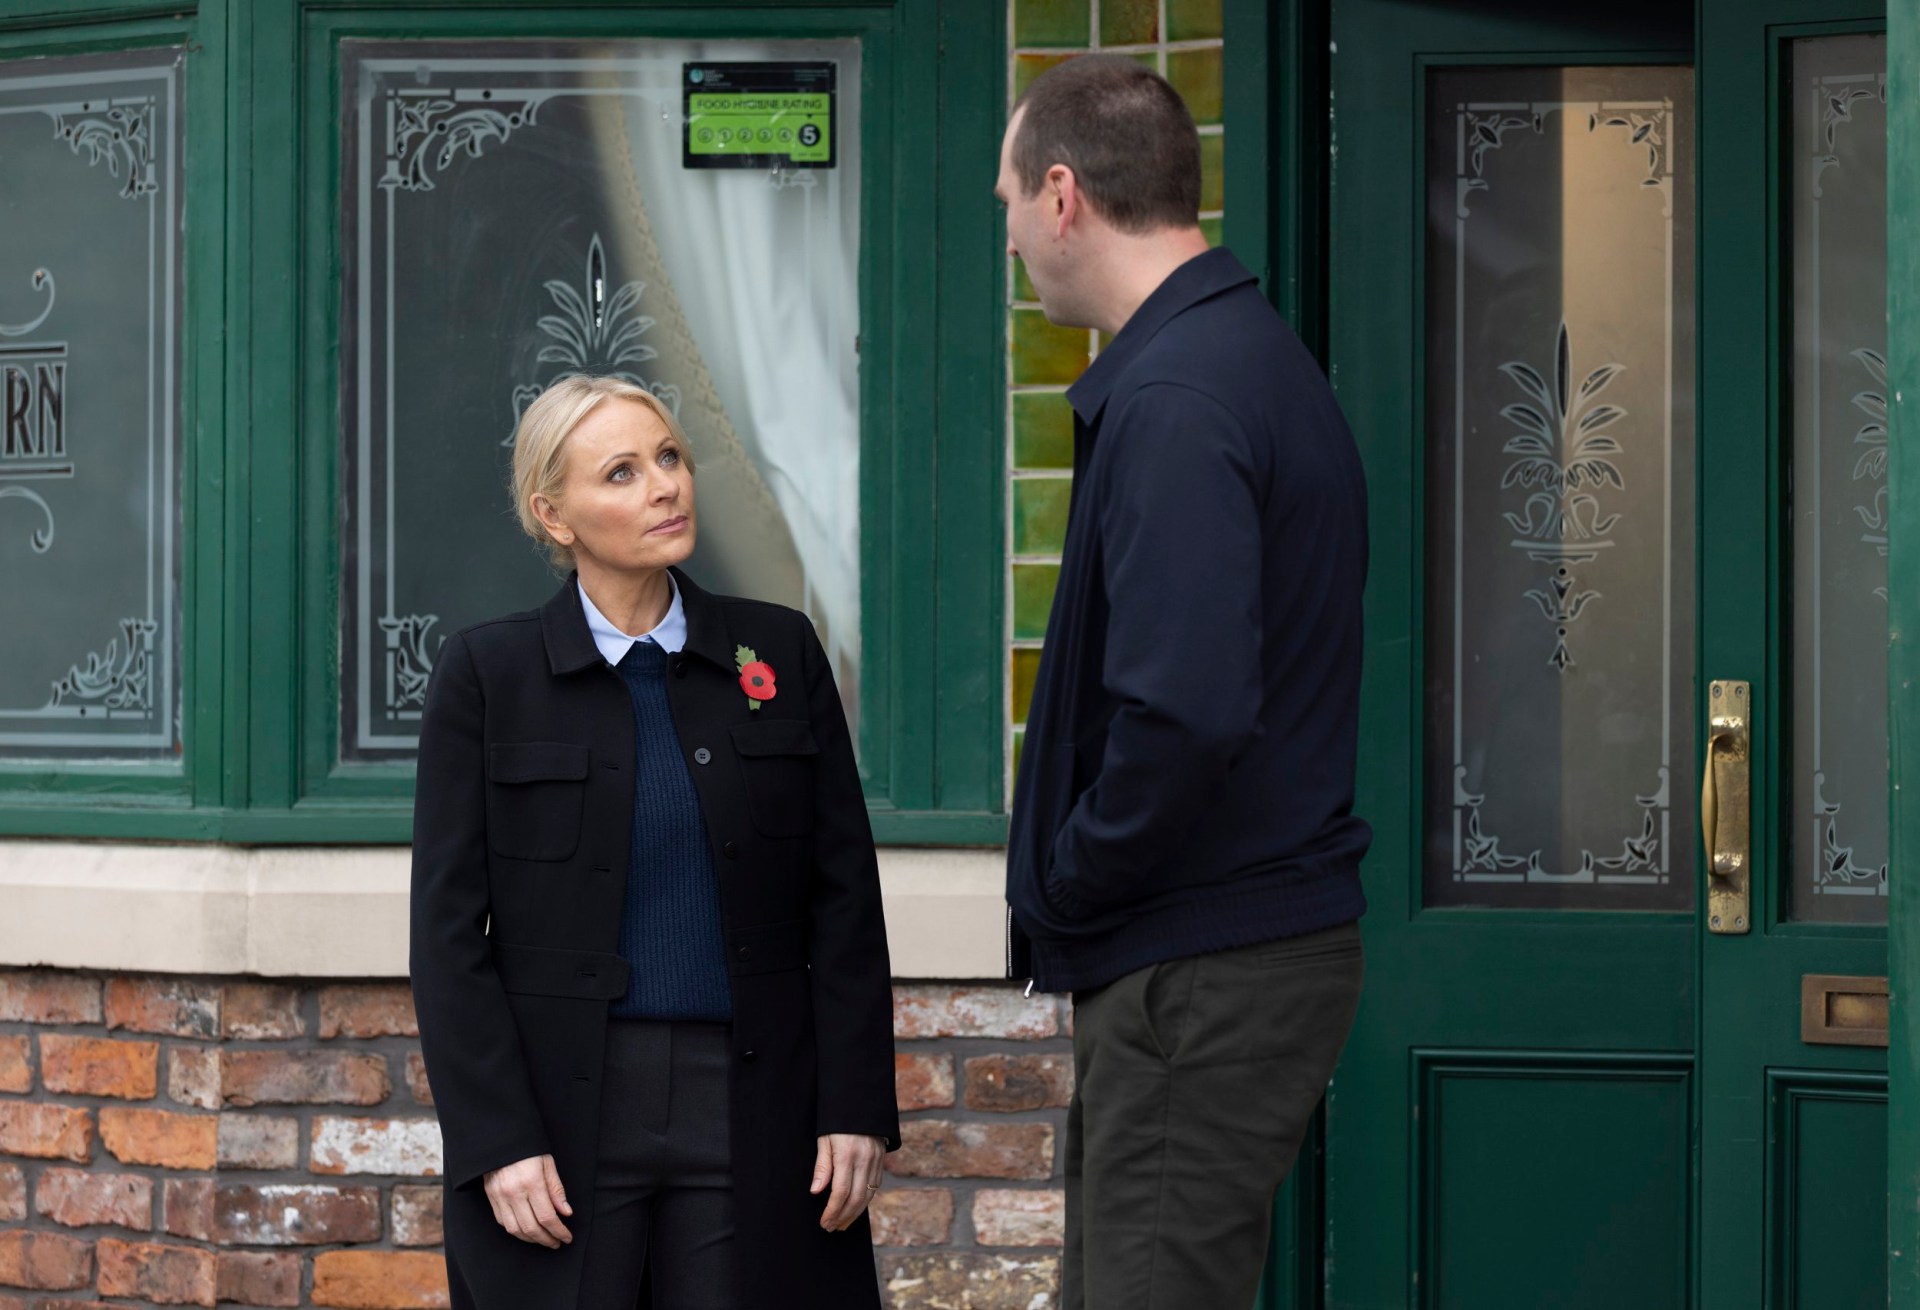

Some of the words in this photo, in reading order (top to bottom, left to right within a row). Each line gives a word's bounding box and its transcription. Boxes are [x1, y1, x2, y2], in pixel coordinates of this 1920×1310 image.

[697, 99, 731, 109] FOOD
[733, 99, 779, 109] HYGIENE
[783, 99, 822, 109] RATING
[802, 126, 817, 145] 5
